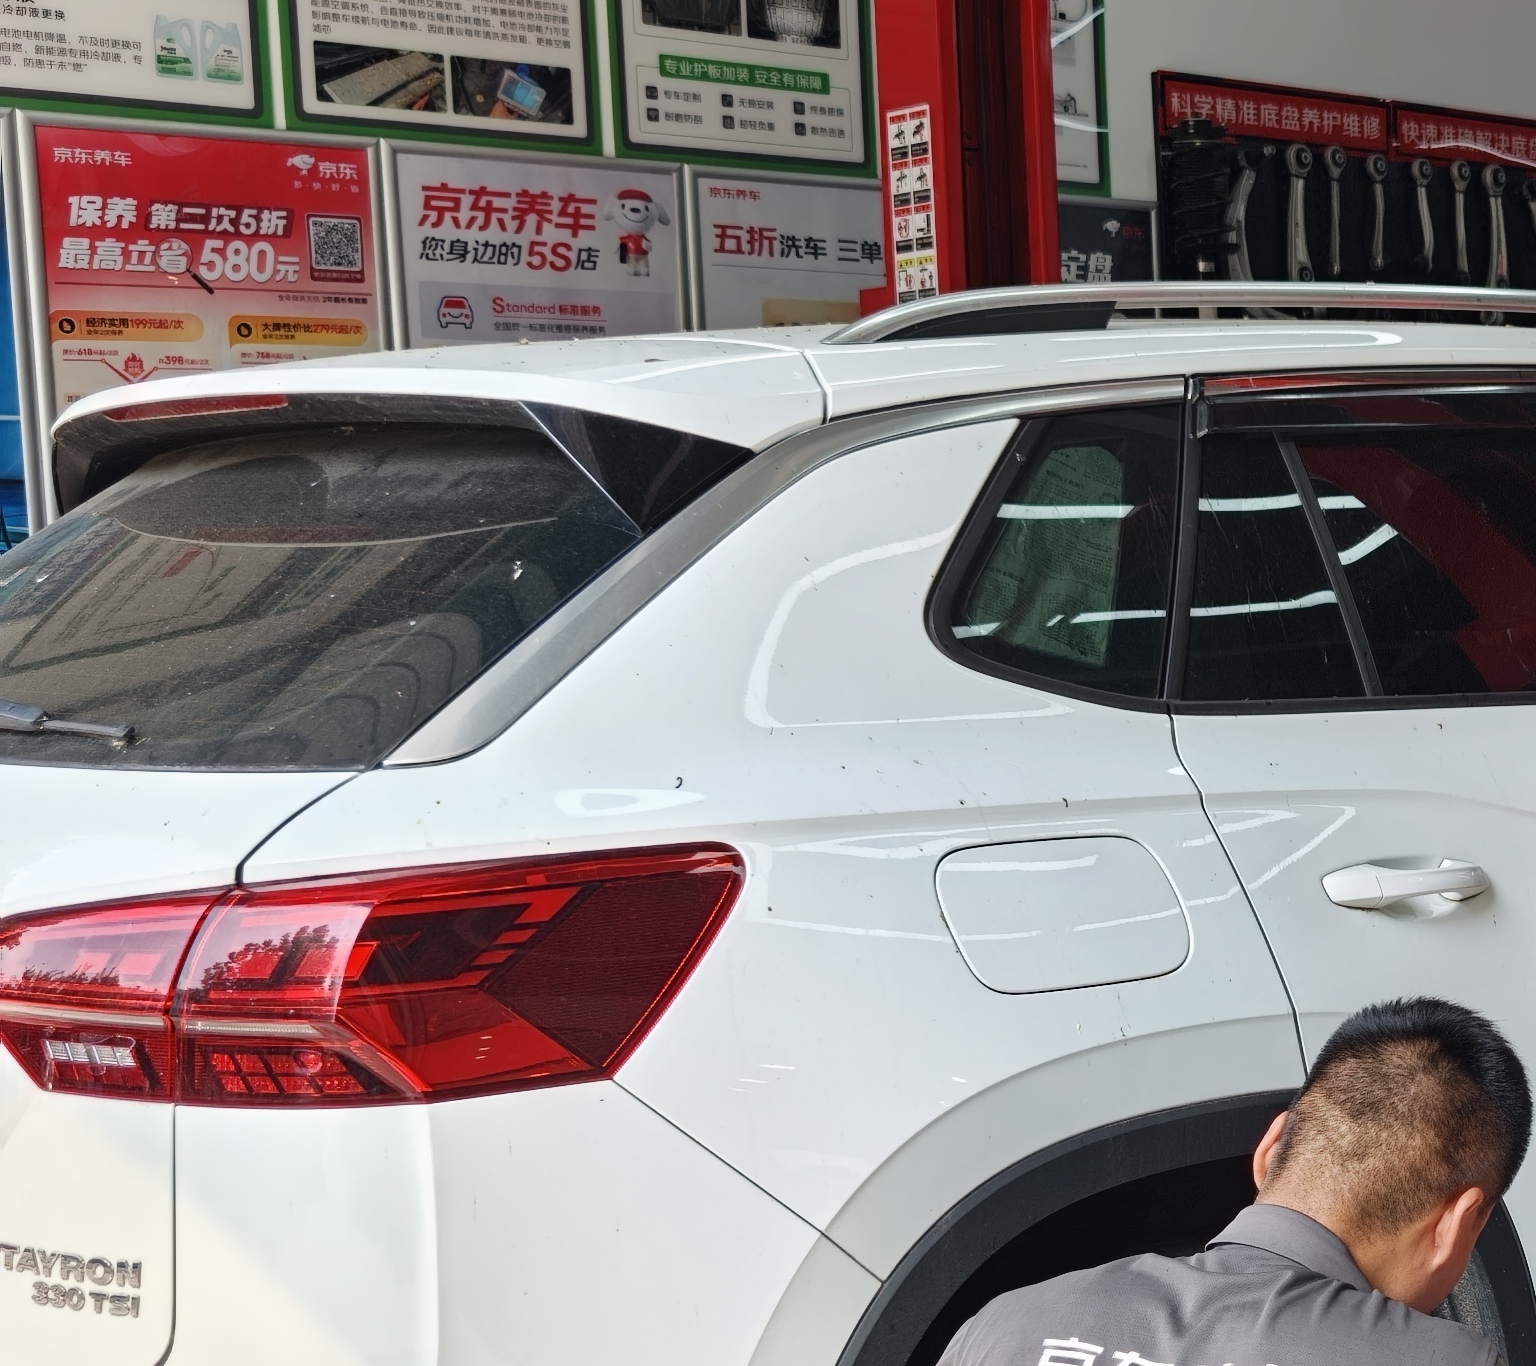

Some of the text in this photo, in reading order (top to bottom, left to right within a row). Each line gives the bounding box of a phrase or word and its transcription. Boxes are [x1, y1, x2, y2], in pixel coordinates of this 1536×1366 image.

[663, 58, 823, 90] 专业护板加装 安全有保障
[1169, 90, 1382, 141] 科学精准底盘养护维修
[53, 146, 132, 167] 京东养车
[317, 161, 358, 181] 京东
[417, 182, 598, 238] 京东养车
[708, 186, 761, 203] 京东养车
[68, 195, 287, 236] 保养 第二次5折
[419, 236, 600, 272] 您身边的5S店
[712, 222, 828, 262] 五折洗车
[491, 296, 602, 317] Standard 标准服务
[0, 1242, 143, 1289] TAYRON
[31, 1280, 141, 1319] 330 TSI
